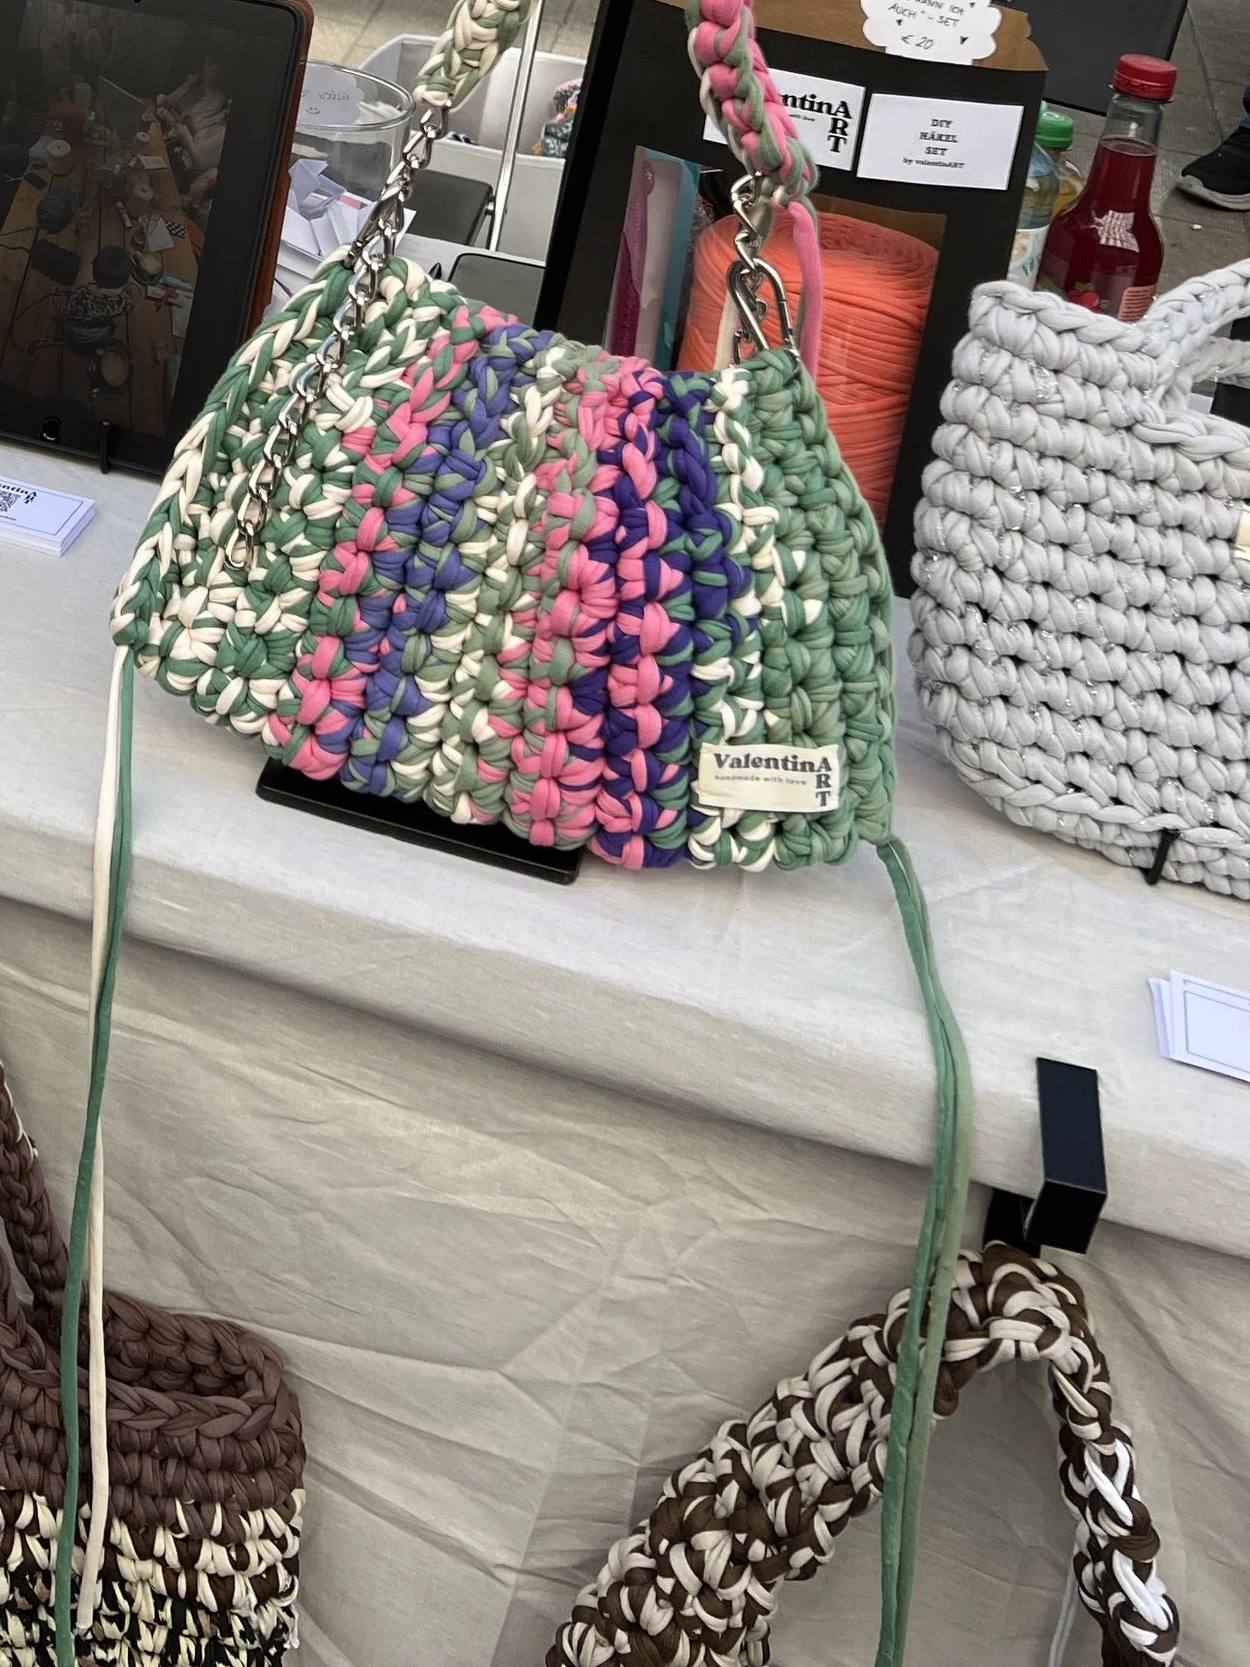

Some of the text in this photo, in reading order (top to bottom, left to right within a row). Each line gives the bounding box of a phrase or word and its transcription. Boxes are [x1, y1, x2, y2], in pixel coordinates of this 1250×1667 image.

[915, 36, 934, 50] 20
[931, 119, 953, 128] DIY
[925, 146, 948, 156] SET
